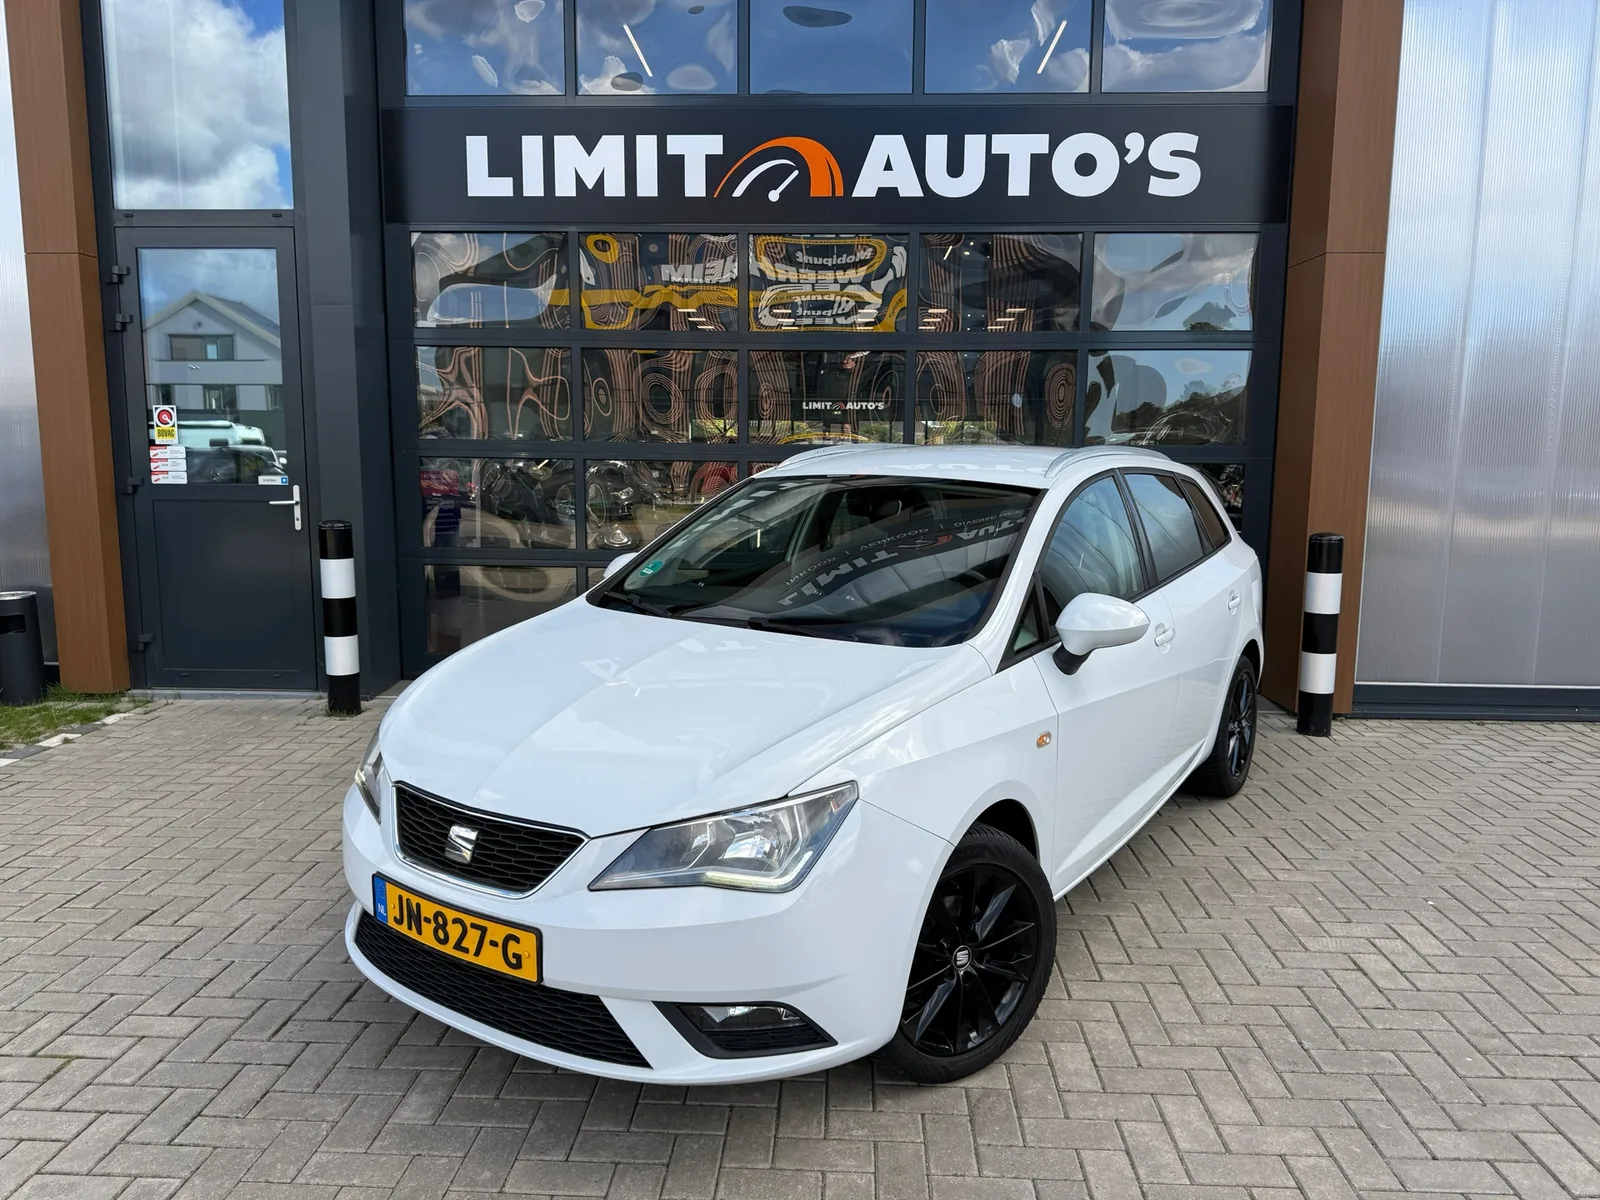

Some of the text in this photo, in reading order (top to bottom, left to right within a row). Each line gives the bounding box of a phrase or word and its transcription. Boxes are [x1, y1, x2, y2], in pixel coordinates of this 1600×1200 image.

[466, 131, 1202, 199] LIMIT AUTO'S
[802, 401, 832, 410] LIMIT
[157, 429, 175, 438] BOVAG
[377, 894, 523, 970] NL JN-827-G
